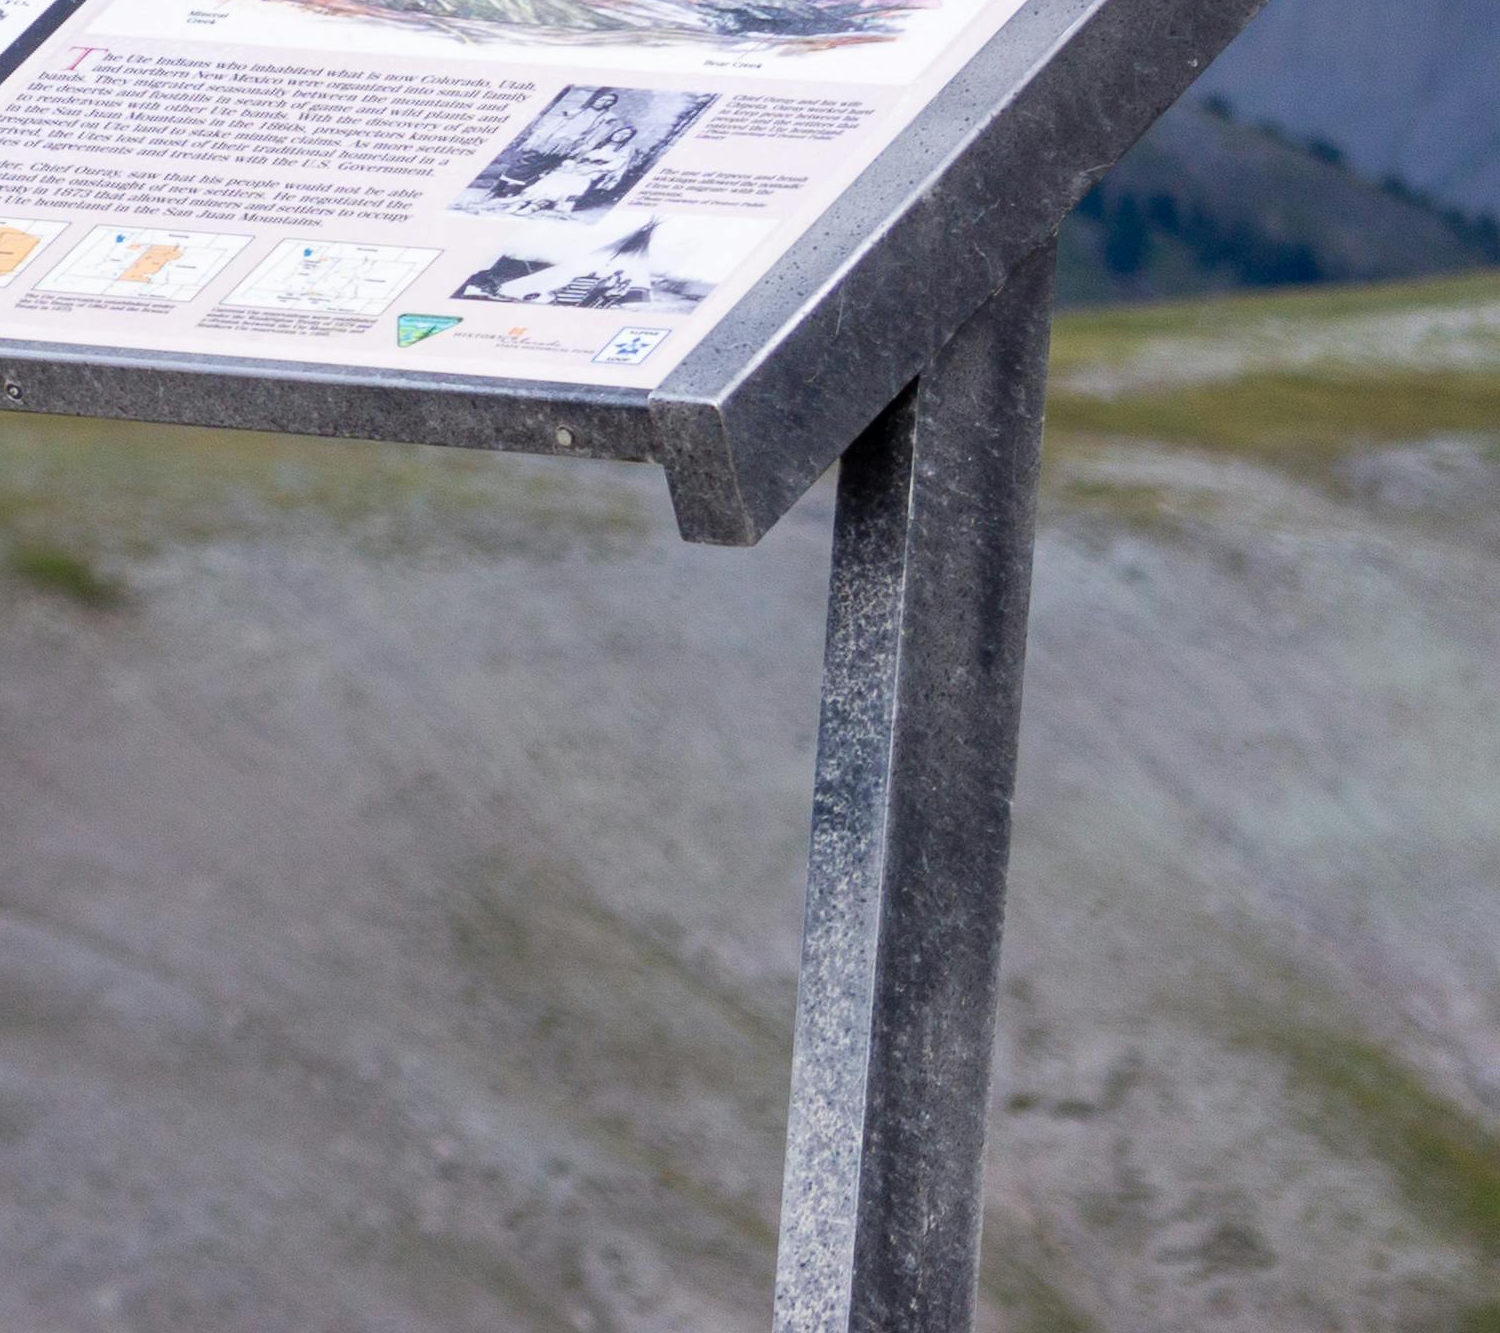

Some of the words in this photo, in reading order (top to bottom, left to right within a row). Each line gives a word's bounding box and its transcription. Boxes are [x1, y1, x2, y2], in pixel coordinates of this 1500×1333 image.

[92, 65, 124, 74] and
[123, 67, 190, 78] northern
[192, 71, 228, 81] New
[229, 73, 284, 85] Mexico
[287, 79, 324, 88] were
[326, 82, 404, 93] organized
[403, 86, 435, 95] into
[436, 89, 482, 99] small
[482, 90, 531, 103] family
[126, 54, 153, 64] Ute
[155, 57, 212, 68] Indians
[216, 61, 248, 71] who
[249, 64, 325, 77] inhabited
[327, 69, 365, 79] what
[366, 71, 382, 80] is
[384, 74, 418, 82] now
[37, 71, 85, 82] bands.
[95, 75, 132, 86] They
[133, 79, 206, 91] migrated
[205, 85, 287, 99] seasonally
[292, 89, 358, 102] between
[361, 95, 388, 104] the
[390, 98, 474, 109] mountains
[476, 103, 510, 112] and
[30, 162, 75, 173] Chief
[127, 171, 161, 180] saw
[163, 173, 196, 183] that
[198, 175, 224, 185] his
[224, 178, 280, 189] people
[285, 183, 334, 193] would
[334, 186, 362, 195] not
[364, 187, 385, 196] be
[387, 189, 424, 199] able
[39, 175, 66, 185] the
[68, 178, 146, 191] onslaught
[148, 183, 169, 192] of
[168, 186, 202, 195] new
[273, 191, 297, 201] He
[299, 196, 385, 208] negotiated
[386, 200, 413, 210] the
[4, 195, 32, 205] Ute
[33, 197, 114, 211] homeland
[114, 203, 130, 213] in
[133, 205, 160, 215] the
[162, 207, 194, 217] San
[196, 210, 236, 221] Juan
[32, 186, 49, 195] in
[53, 187, 93, 198] 1873
[93, 191, 126, 201] that
[127, 193, 189, 205] allowed
[189, 199, 243, 209] miners
[244, 203, 277, 212] and
[276, 205, 336, 216] settlers
[337, 209, 355, 217] to
[357, 211, 409, 223] occupy
